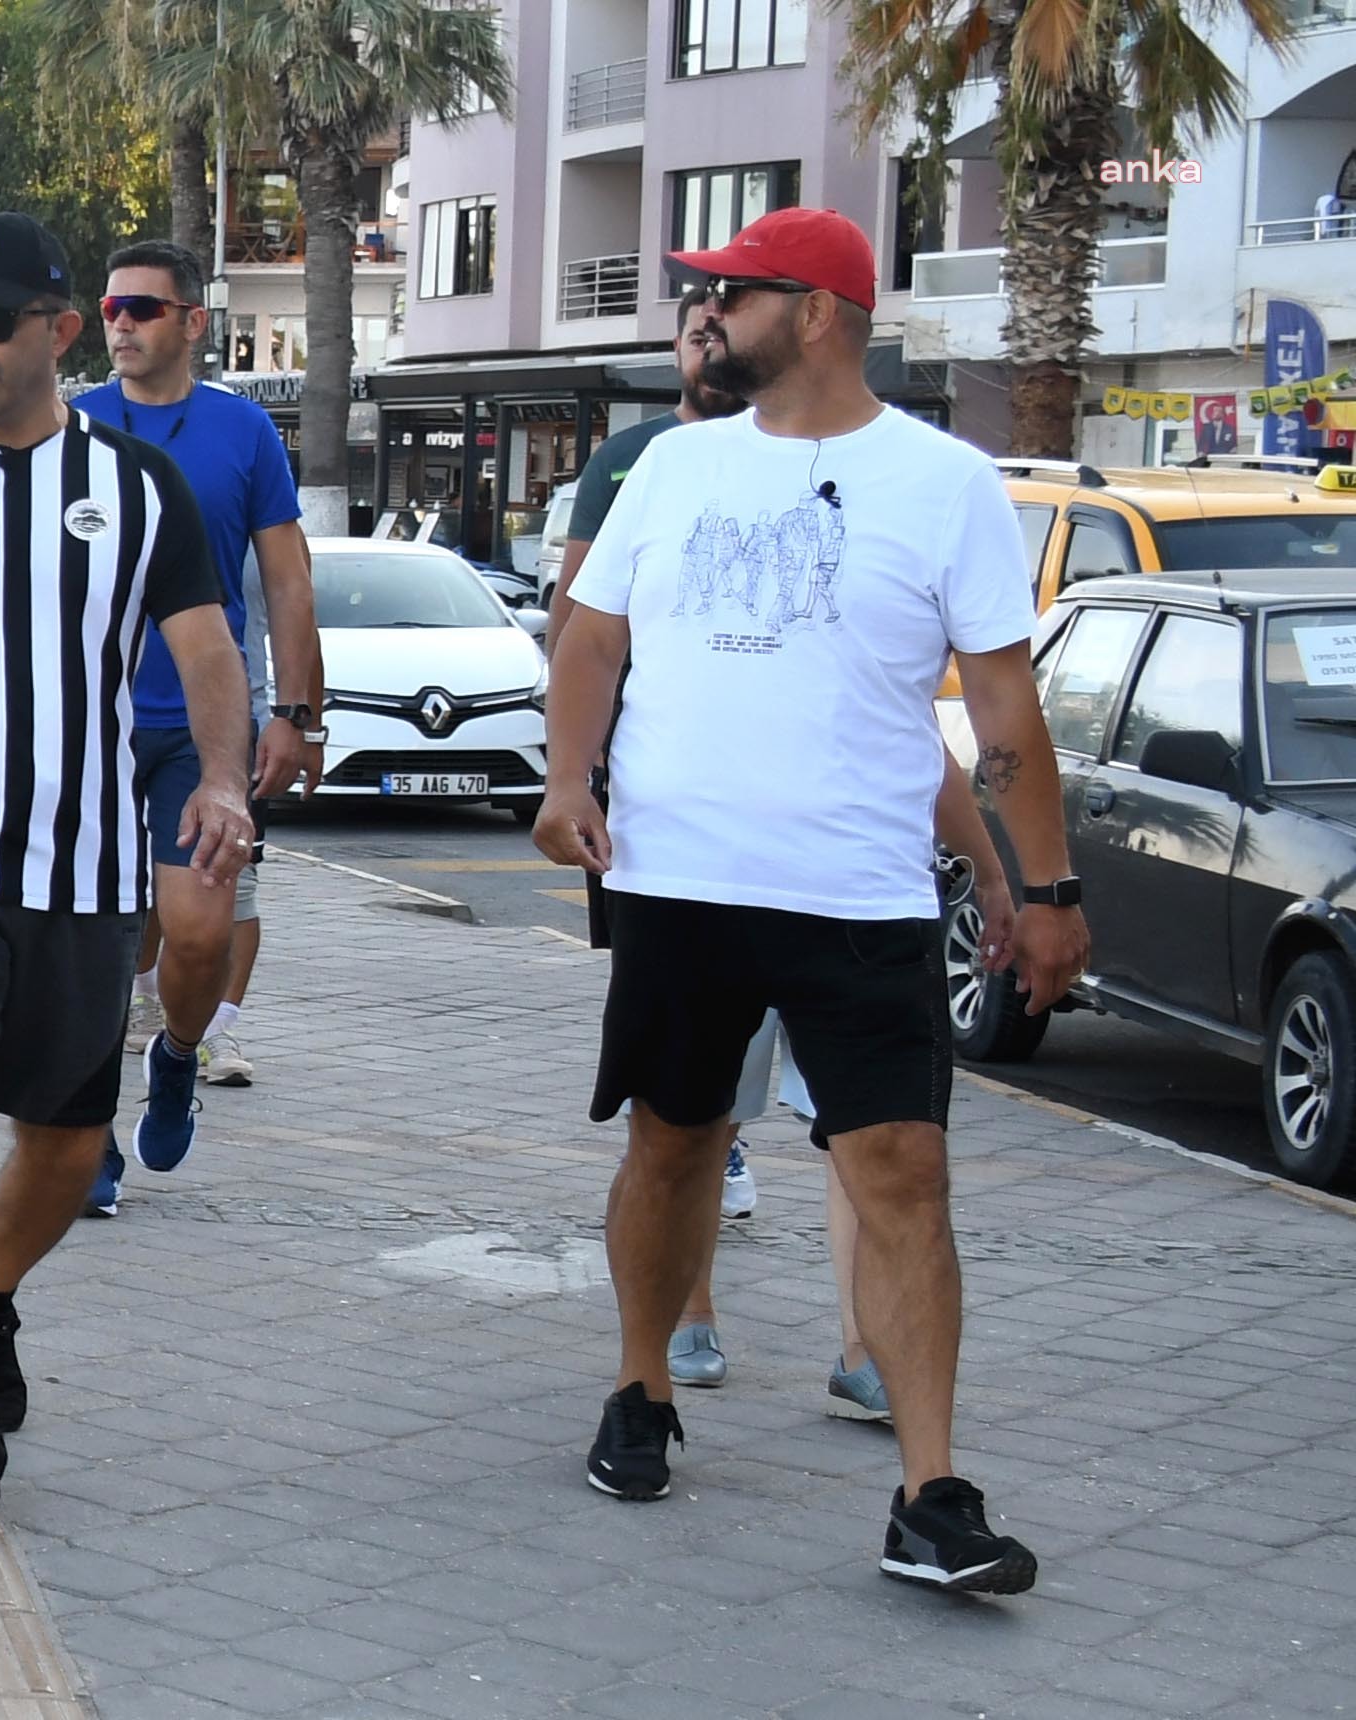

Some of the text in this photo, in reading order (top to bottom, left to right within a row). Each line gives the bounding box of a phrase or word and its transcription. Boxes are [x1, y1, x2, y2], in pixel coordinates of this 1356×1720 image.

[393, 776, 412, 793] 35
[421, 776, 449, 793] AAG
[457, 776, 485, 793] 470
